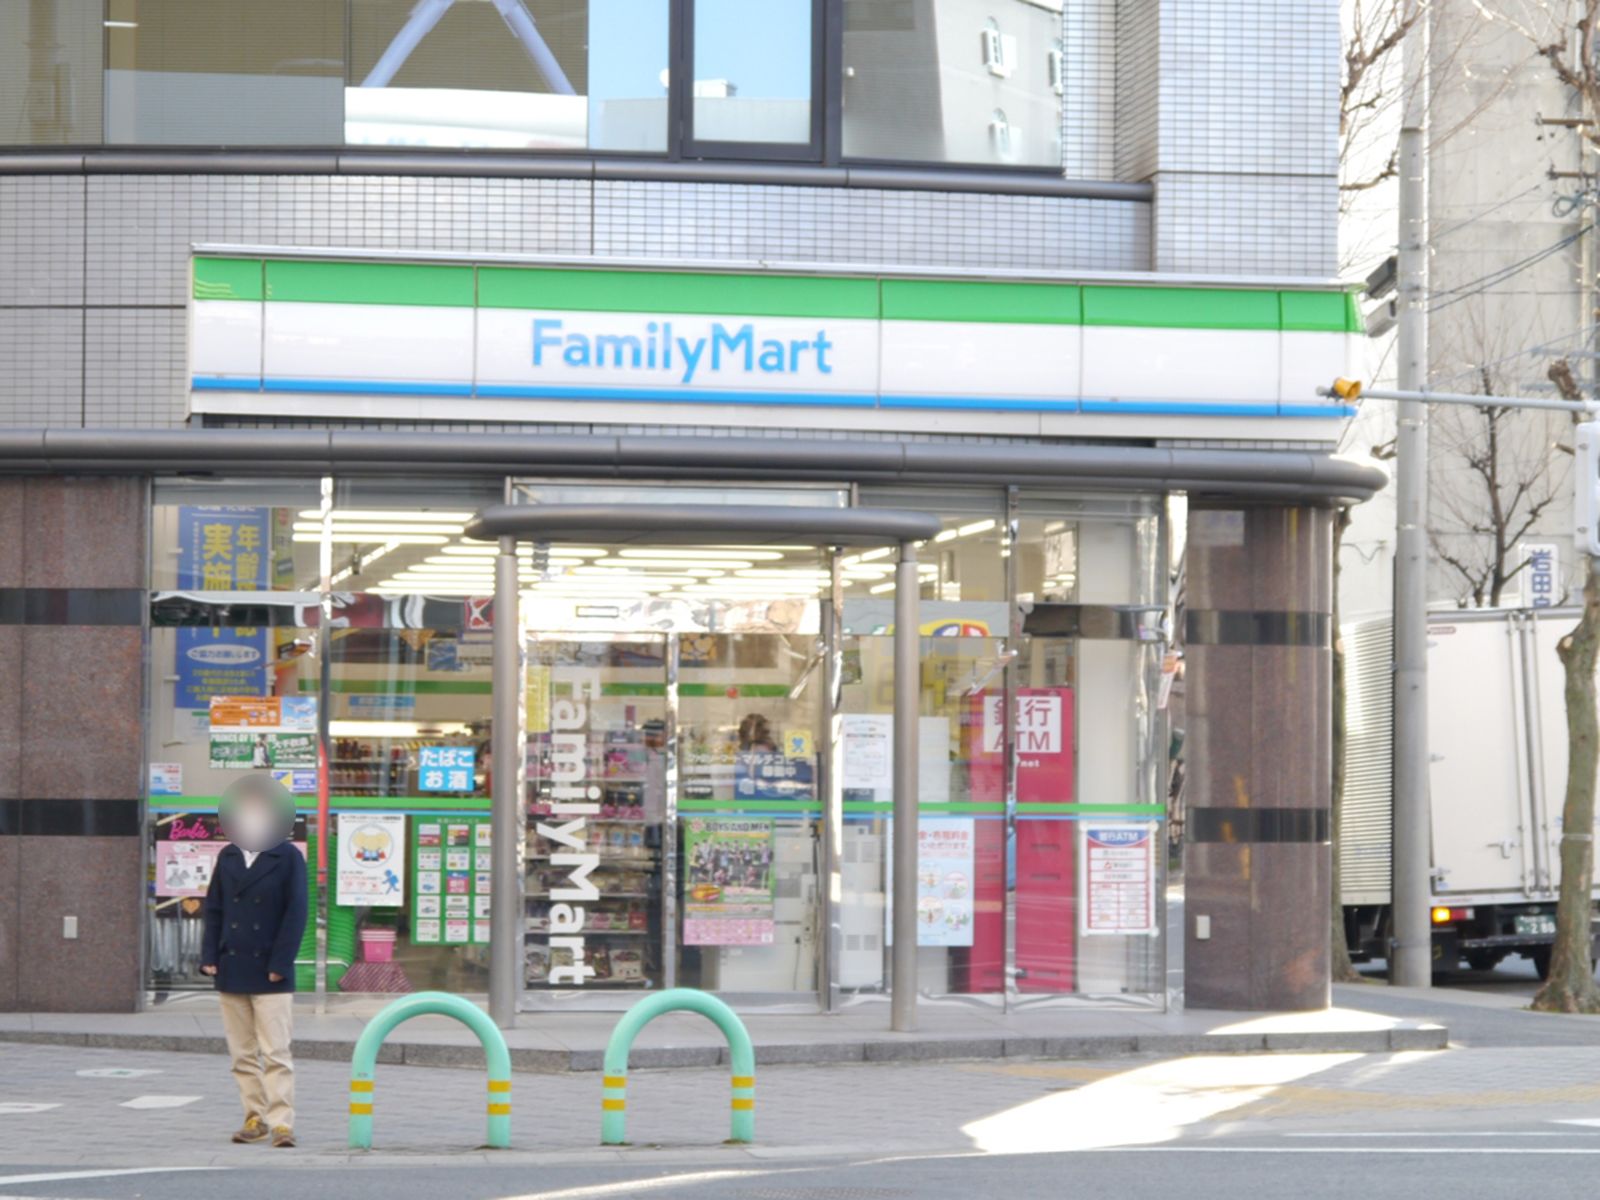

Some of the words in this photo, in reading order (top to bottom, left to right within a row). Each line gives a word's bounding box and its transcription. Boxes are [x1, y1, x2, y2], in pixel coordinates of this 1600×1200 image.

[532, 318, 832, 384] FamilyMart
[420, 749, 474, 767] たばこ
[169, 817, 209, 841] Barbie
[536, 666, 600, 985] FamilyMart
